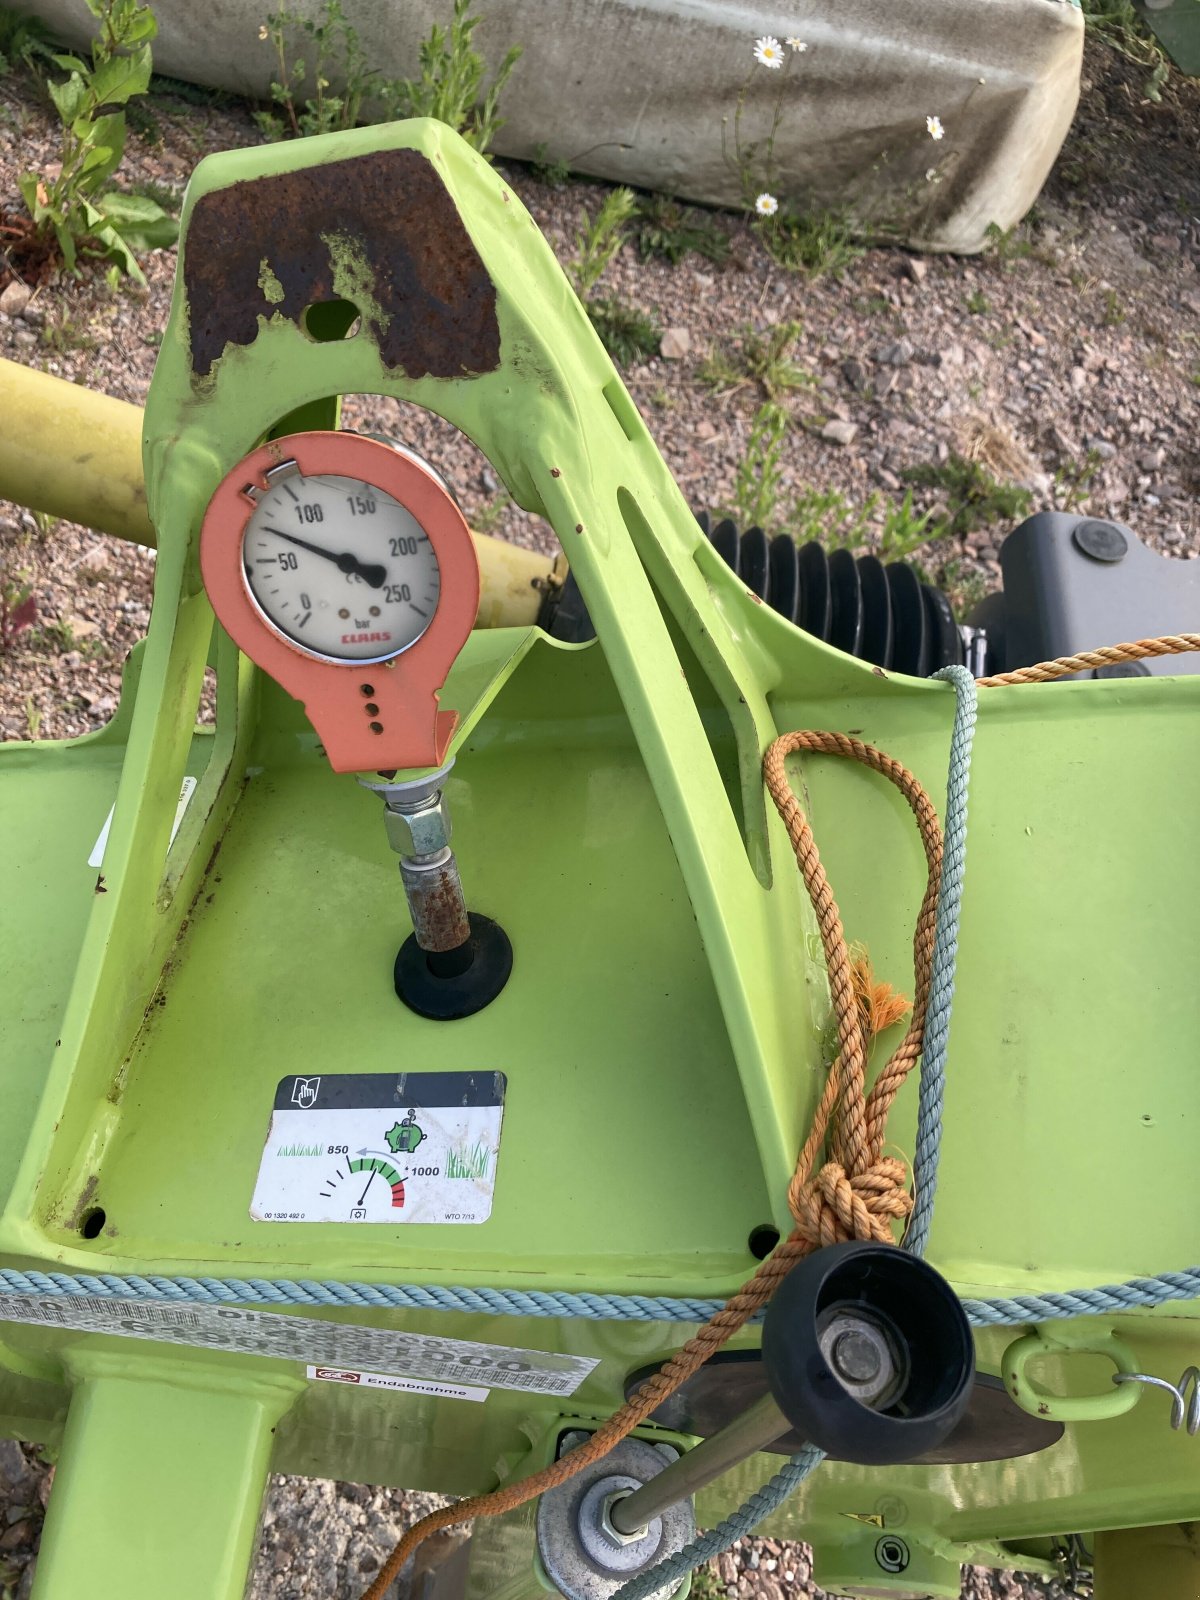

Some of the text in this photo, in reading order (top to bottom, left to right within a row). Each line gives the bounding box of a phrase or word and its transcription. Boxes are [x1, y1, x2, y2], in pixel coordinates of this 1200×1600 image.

[295, 503, 324, 524] 100
[347, 496, 377, 516] 150
[389, 536, 418, 557] 200
[278, 552, 298, 571] 50
[300, 593, 312, 610] 0
[383, 584, 411, 604] 250
[355, 618, 370, 629] bar
[341, 631, 392, 645] CLAAS
[327, 1144, 349, 1155] 850
[411, 1166, 440, 1177] 1000
[444, 1212, 476, 1220] WTO 7/13
[367, 1377, 467, 1396] Endabnahme
